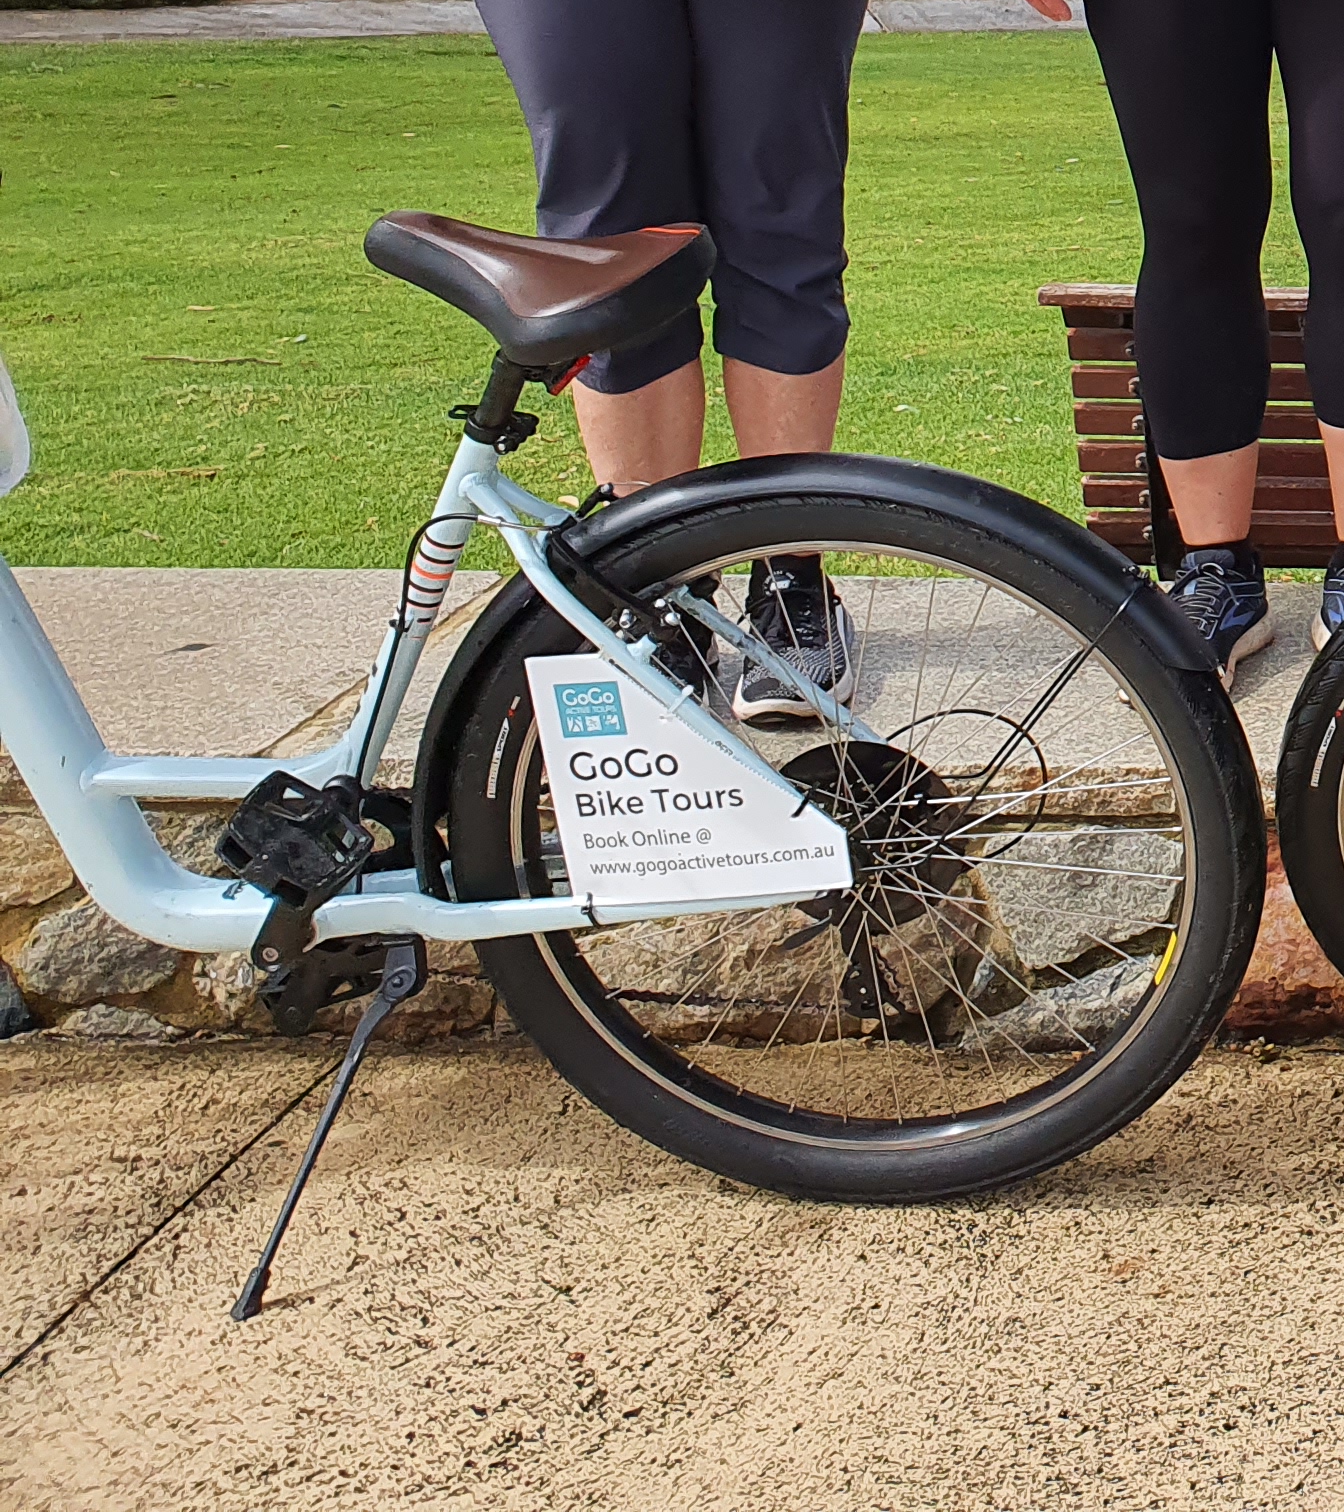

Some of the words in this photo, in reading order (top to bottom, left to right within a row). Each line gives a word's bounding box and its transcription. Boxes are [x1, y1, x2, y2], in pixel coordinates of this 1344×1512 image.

[562, 687, 615, 706] GoGo
[569, 748, 679, 781] GoGo
[575, 791, 644, 817] Bike
[651, 787, 744, 814] Tours
[583, 829, 627, 849] Book
[632, 828, 691, 847] Online
[695, 828, 712, 845] @
[590, 844, 835, 876] www.gogoactivetours.com.au
